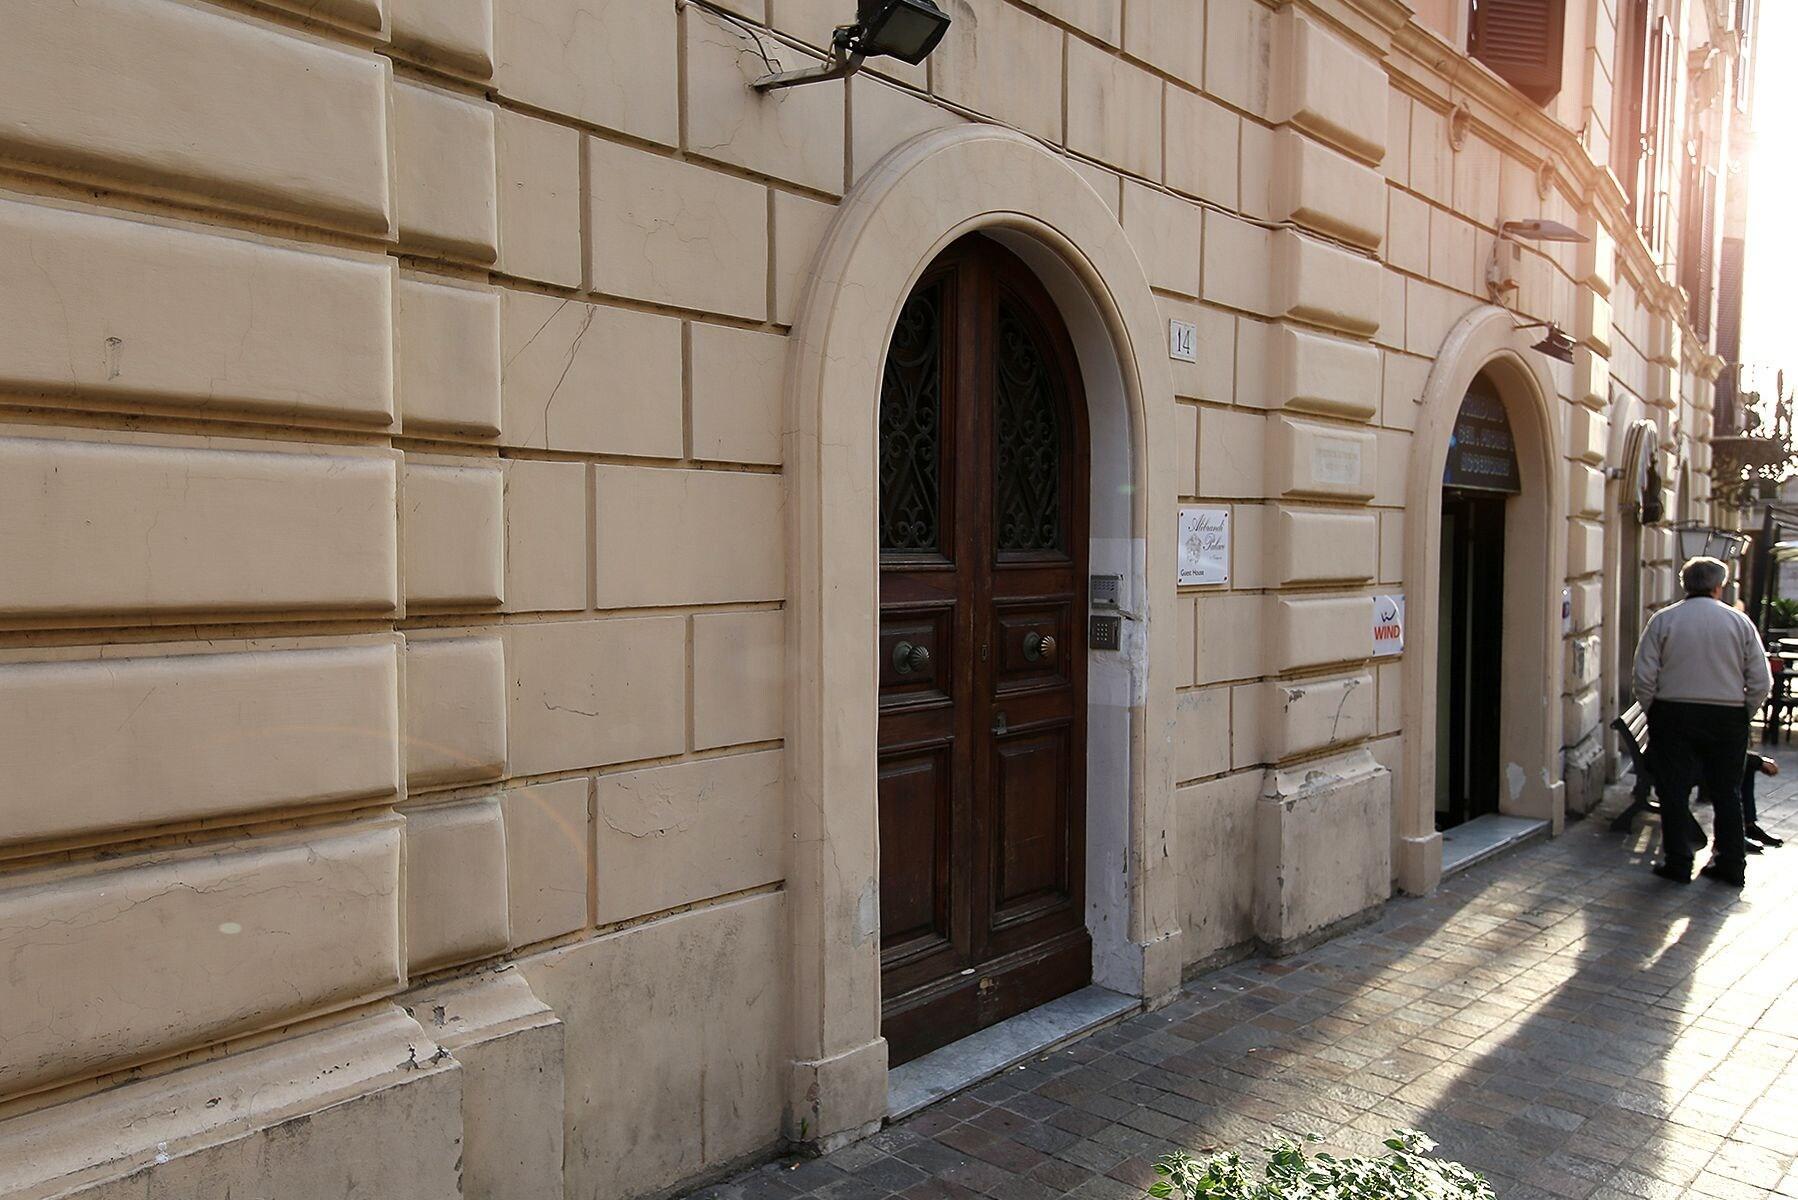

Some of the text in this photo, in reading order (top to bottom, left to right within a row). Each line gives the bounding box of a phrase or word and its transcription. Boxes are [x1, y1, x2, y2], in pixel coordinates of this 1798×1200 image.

[1177, 327, 1190, 354] 14
[1181, 569, 1204, 577] Guest House
[1374, 625, 1401, 640] WIND
